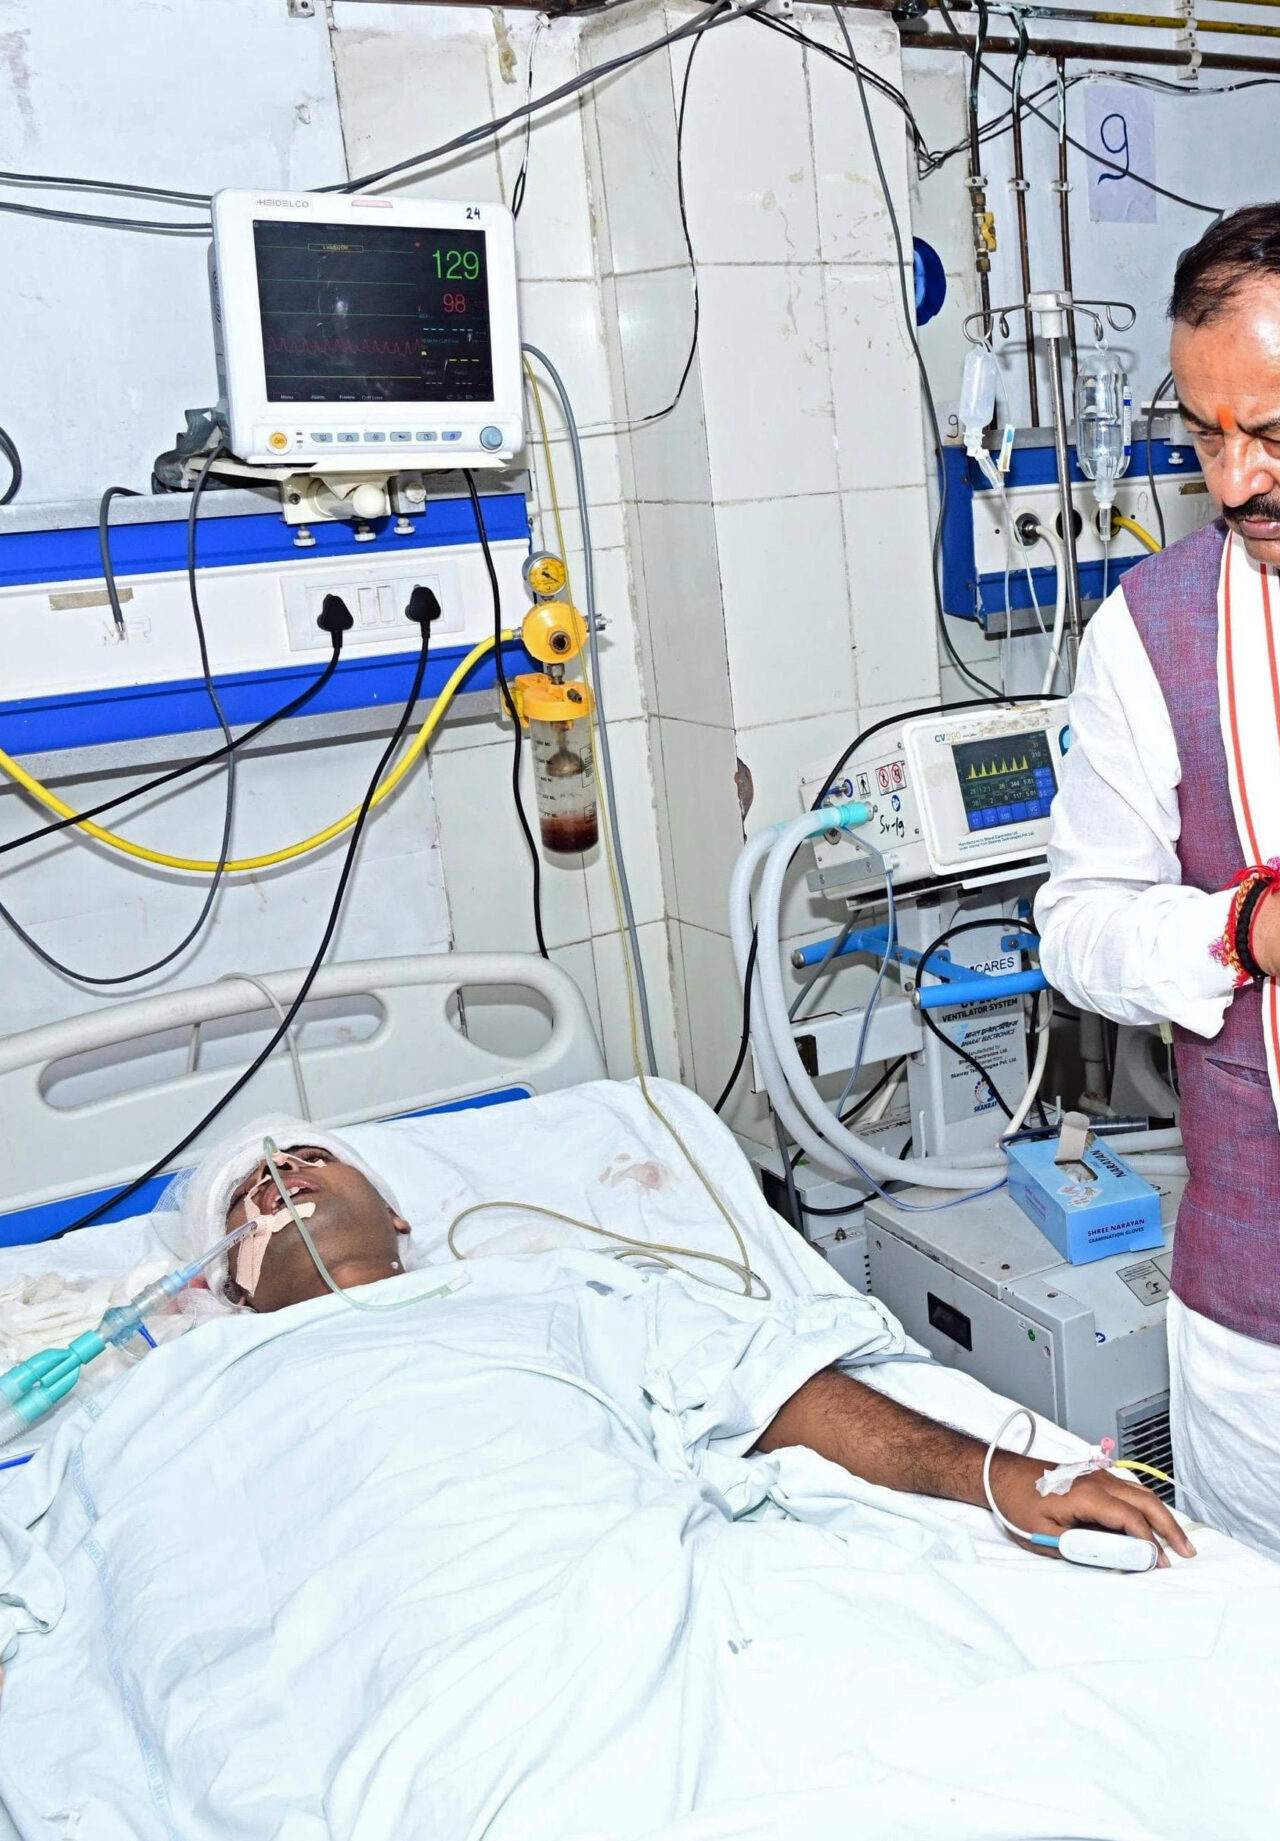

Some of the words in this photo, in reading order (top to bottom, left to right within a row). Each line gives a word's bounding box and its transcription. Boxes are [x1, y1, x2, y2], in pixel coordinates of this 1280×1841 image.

[1098, 113, 1129, 185] 9
[466, 207, 481, 220] 24
[432, 250, 480, 280] 129
[443, 294, 467, 313] 98
[946, 414, 959, 438] 9
[942, 1005, 988, 1022] VENTILATOR
[988, 998, 1018, 1011] SYSTEM
[1088, 1226, 1109, 1236] SHREE
[1110, 1218, 1145, 1231] NARAYAN
[1088, 1232, 1125, 1244] EXAMINATION
[1125, 1226, 1145, 1235] GLOVES
